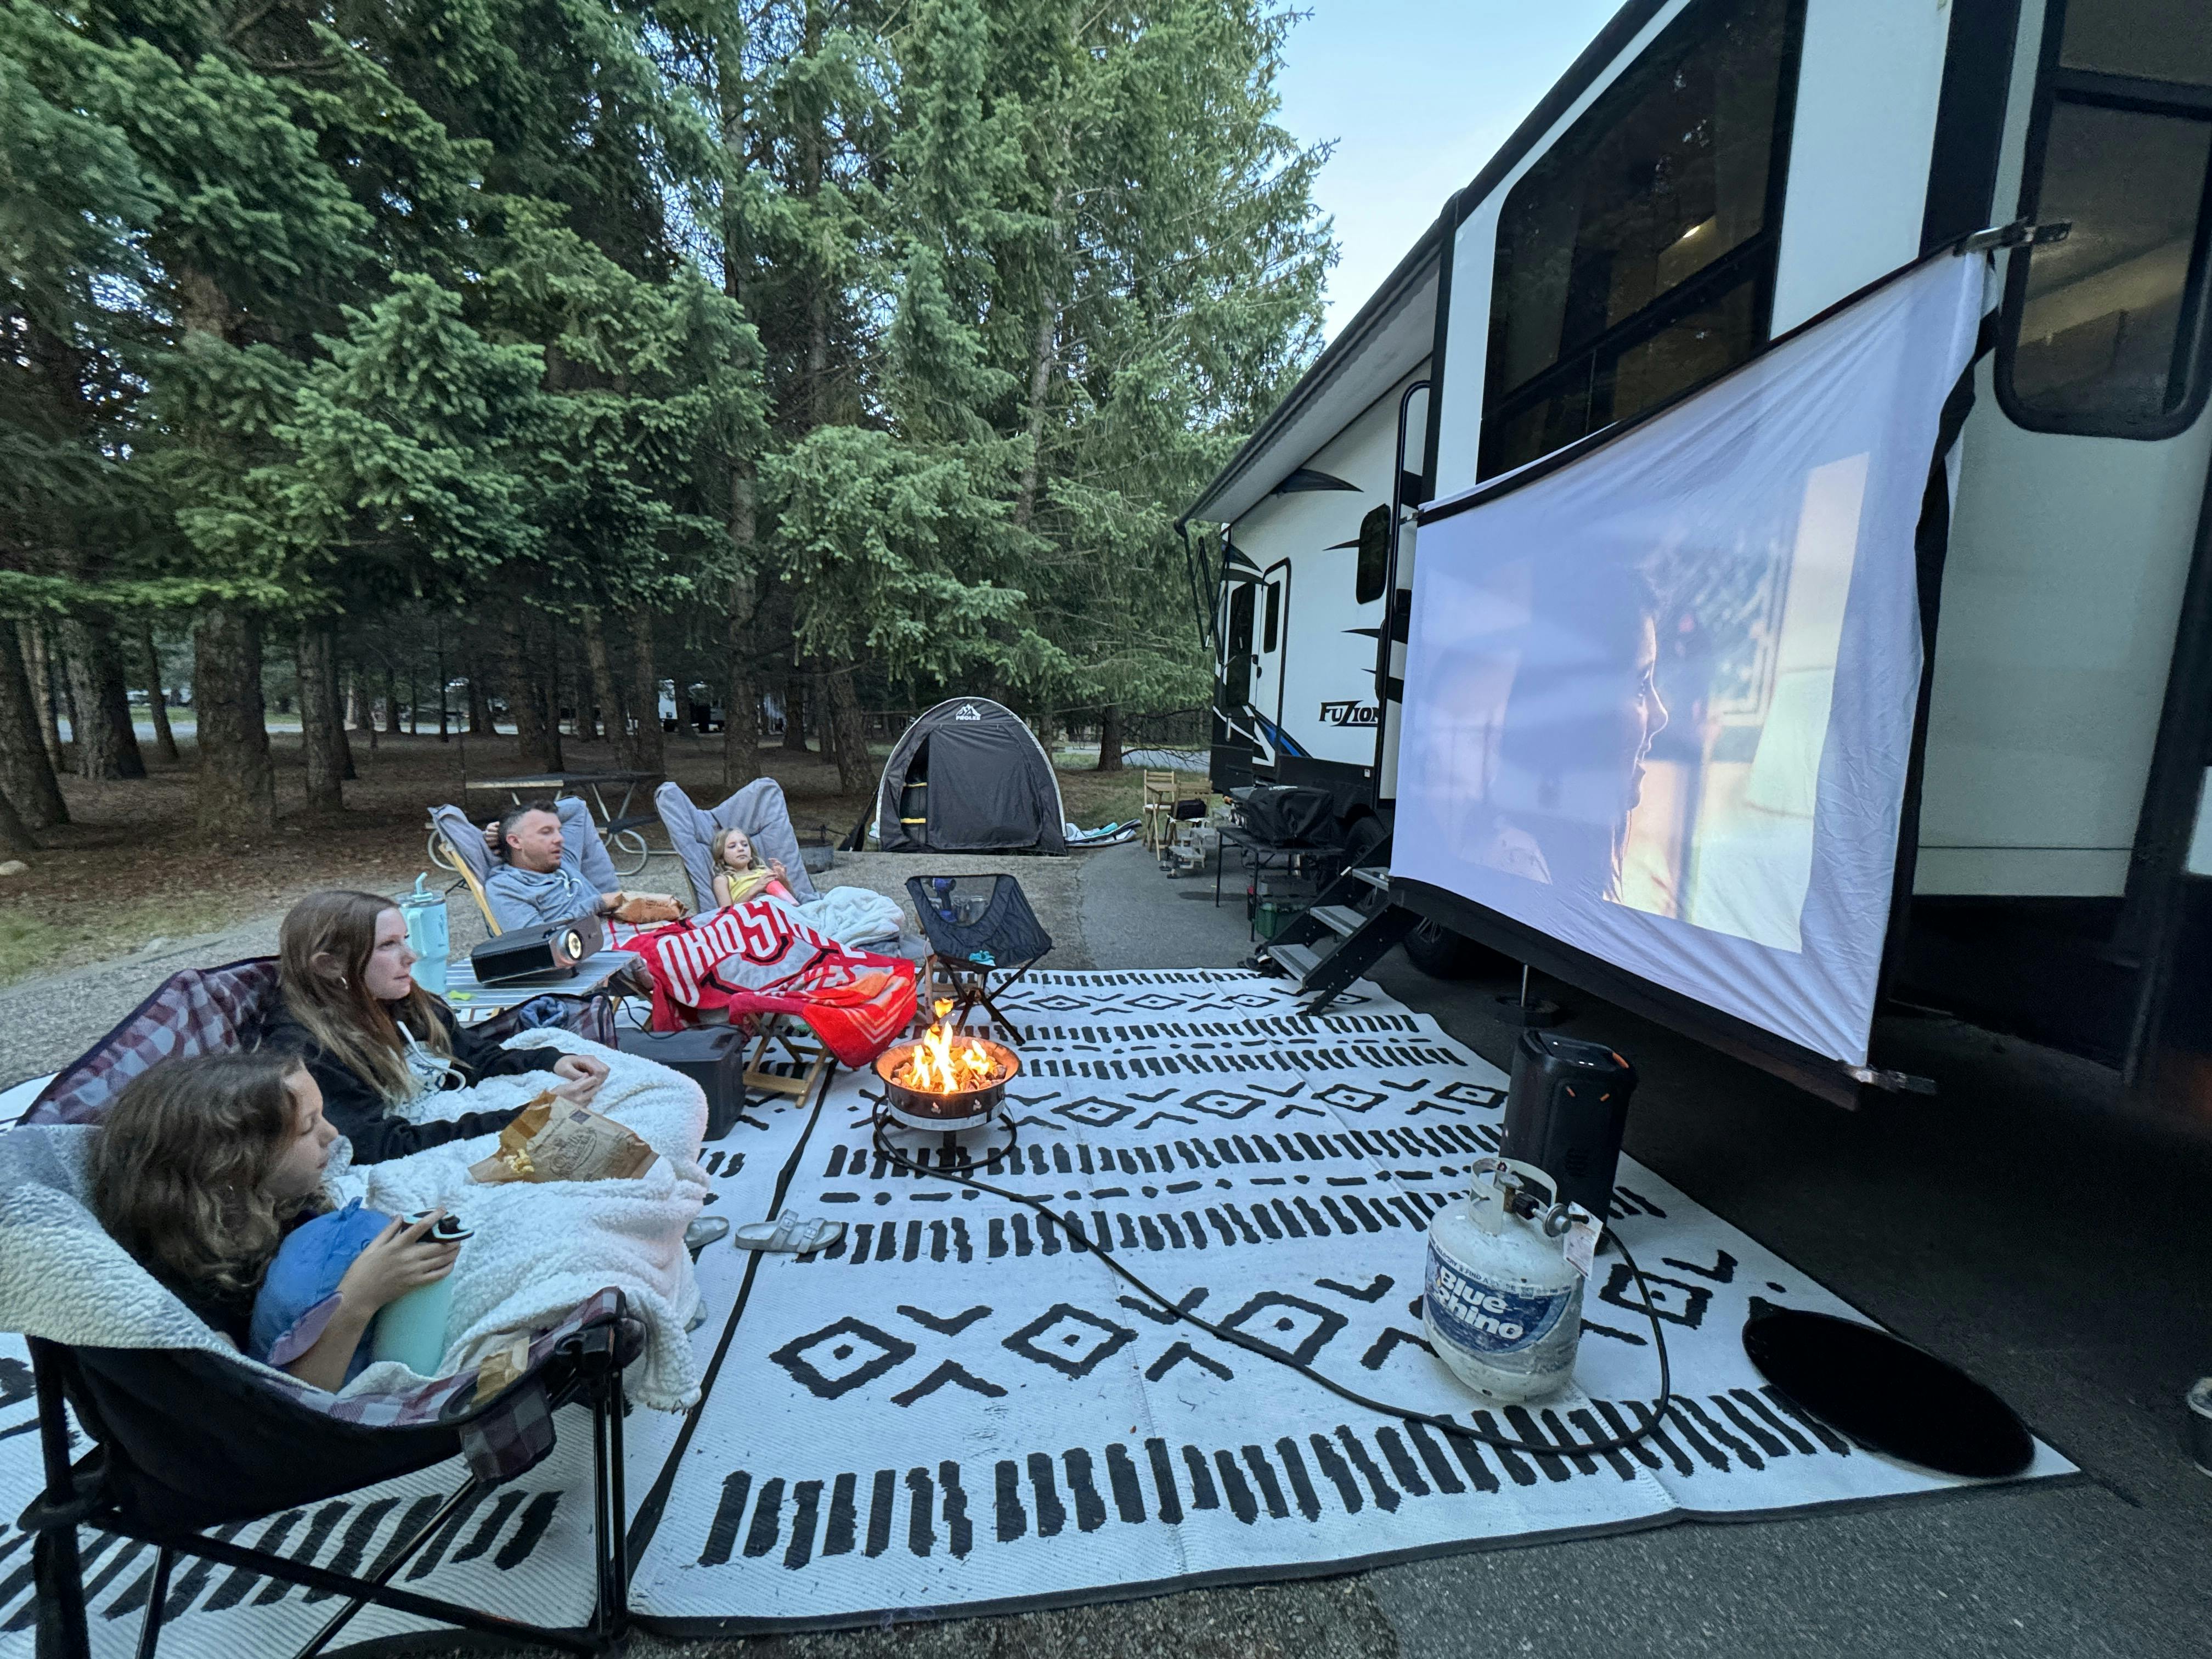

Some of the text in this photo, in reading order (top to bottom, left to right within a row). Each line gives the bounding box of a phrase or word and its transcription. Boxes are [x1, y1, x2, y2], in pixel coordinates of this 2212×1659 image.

[657, 913, 747, 1007] OHIO
[1433, 1286, 1523, 1340] Rhino
[1440, 1265, 1507, 1314] Blue
